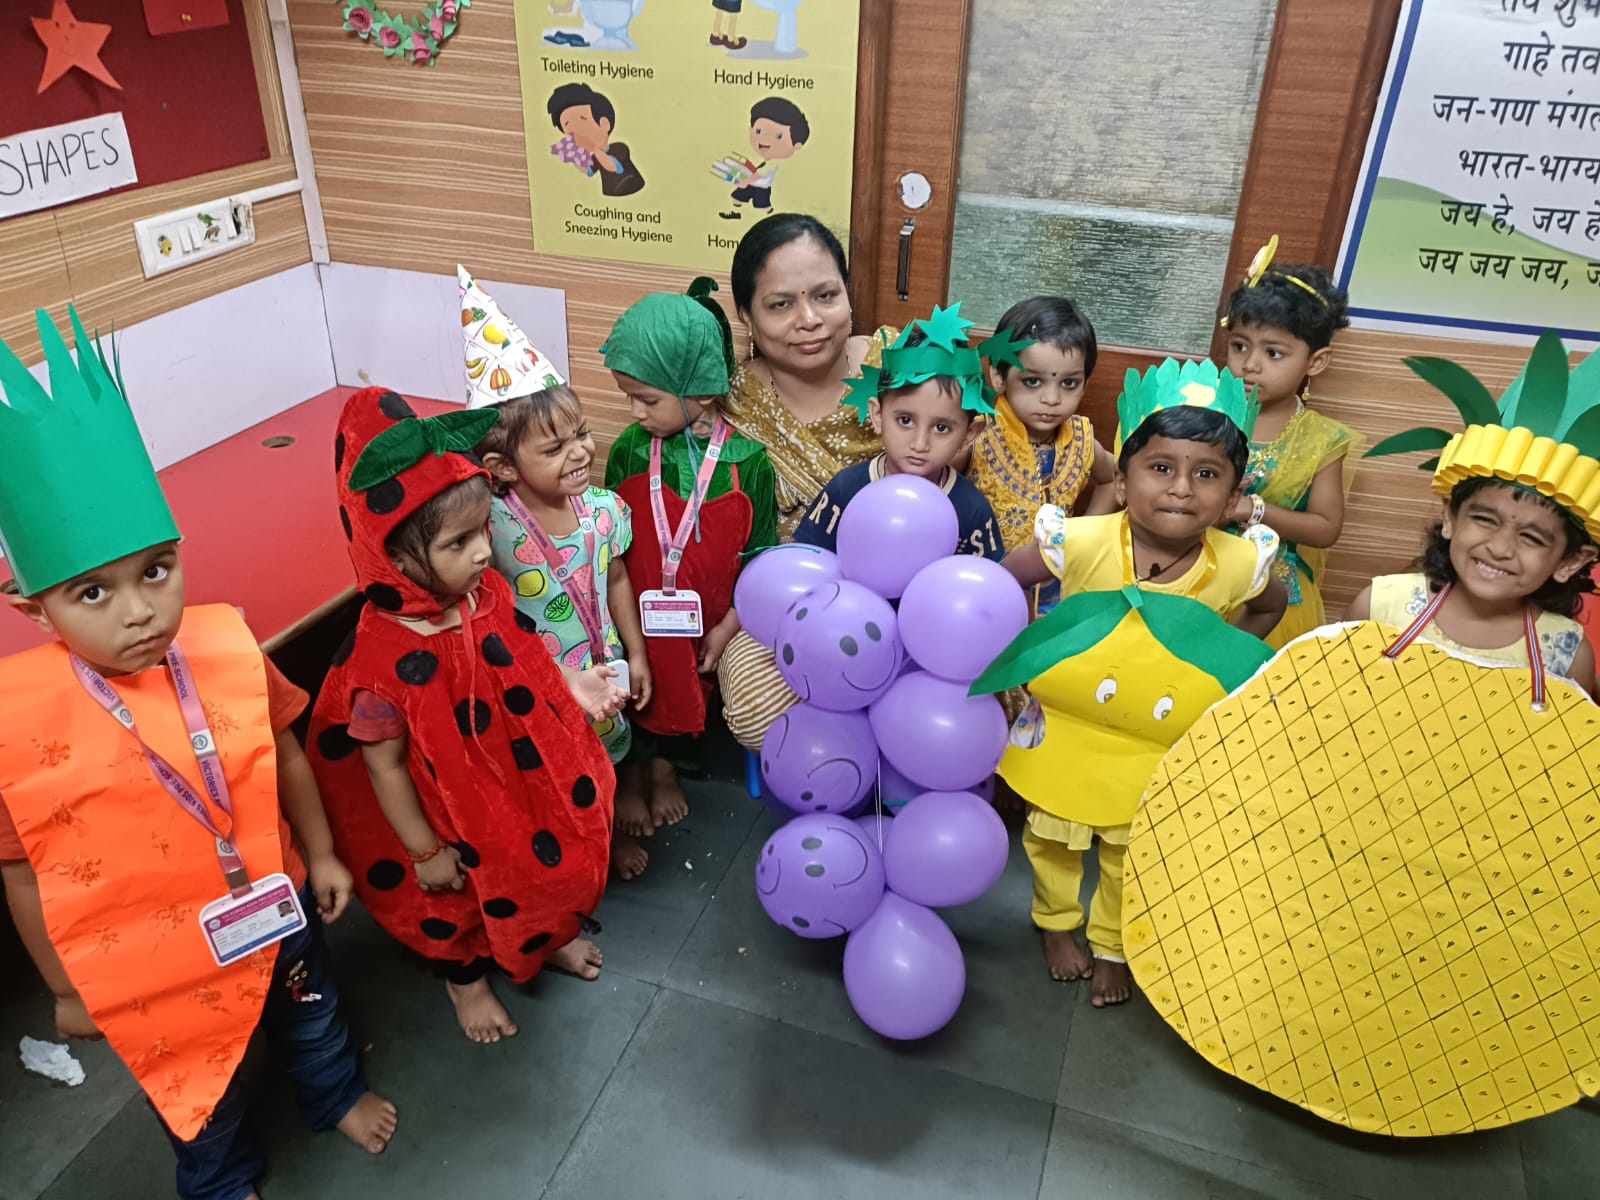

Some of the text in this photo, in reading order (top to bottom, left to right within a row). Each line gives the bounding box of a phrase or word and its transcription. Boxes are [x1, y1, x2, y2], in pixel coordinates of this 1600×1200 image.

[541, 57, 654, 79] Toileting Hygiene
[1503, 30, 1555, 77] गाहे
[714, 68, 814, 90] Hand Hygiene
[1433, 94, 1540, 127] जन-गण
[0, 127, 119, 196] SHAPES
[565, 220, 673, 243] Sneezing Hygiene
[574, 203, 661, 224] Coughing and
[1441, 200, 1487, 227] जय
[1491, 193, 1515, 236] हे,
[1533, 207, 1580, 234] जय
[1419, 248, 1464, 275] जय
[1470, 252, 1516, 280] जय
[1521, 257, 1569, 290] जय,
[201, 759, 219, 798] VICTORIES
